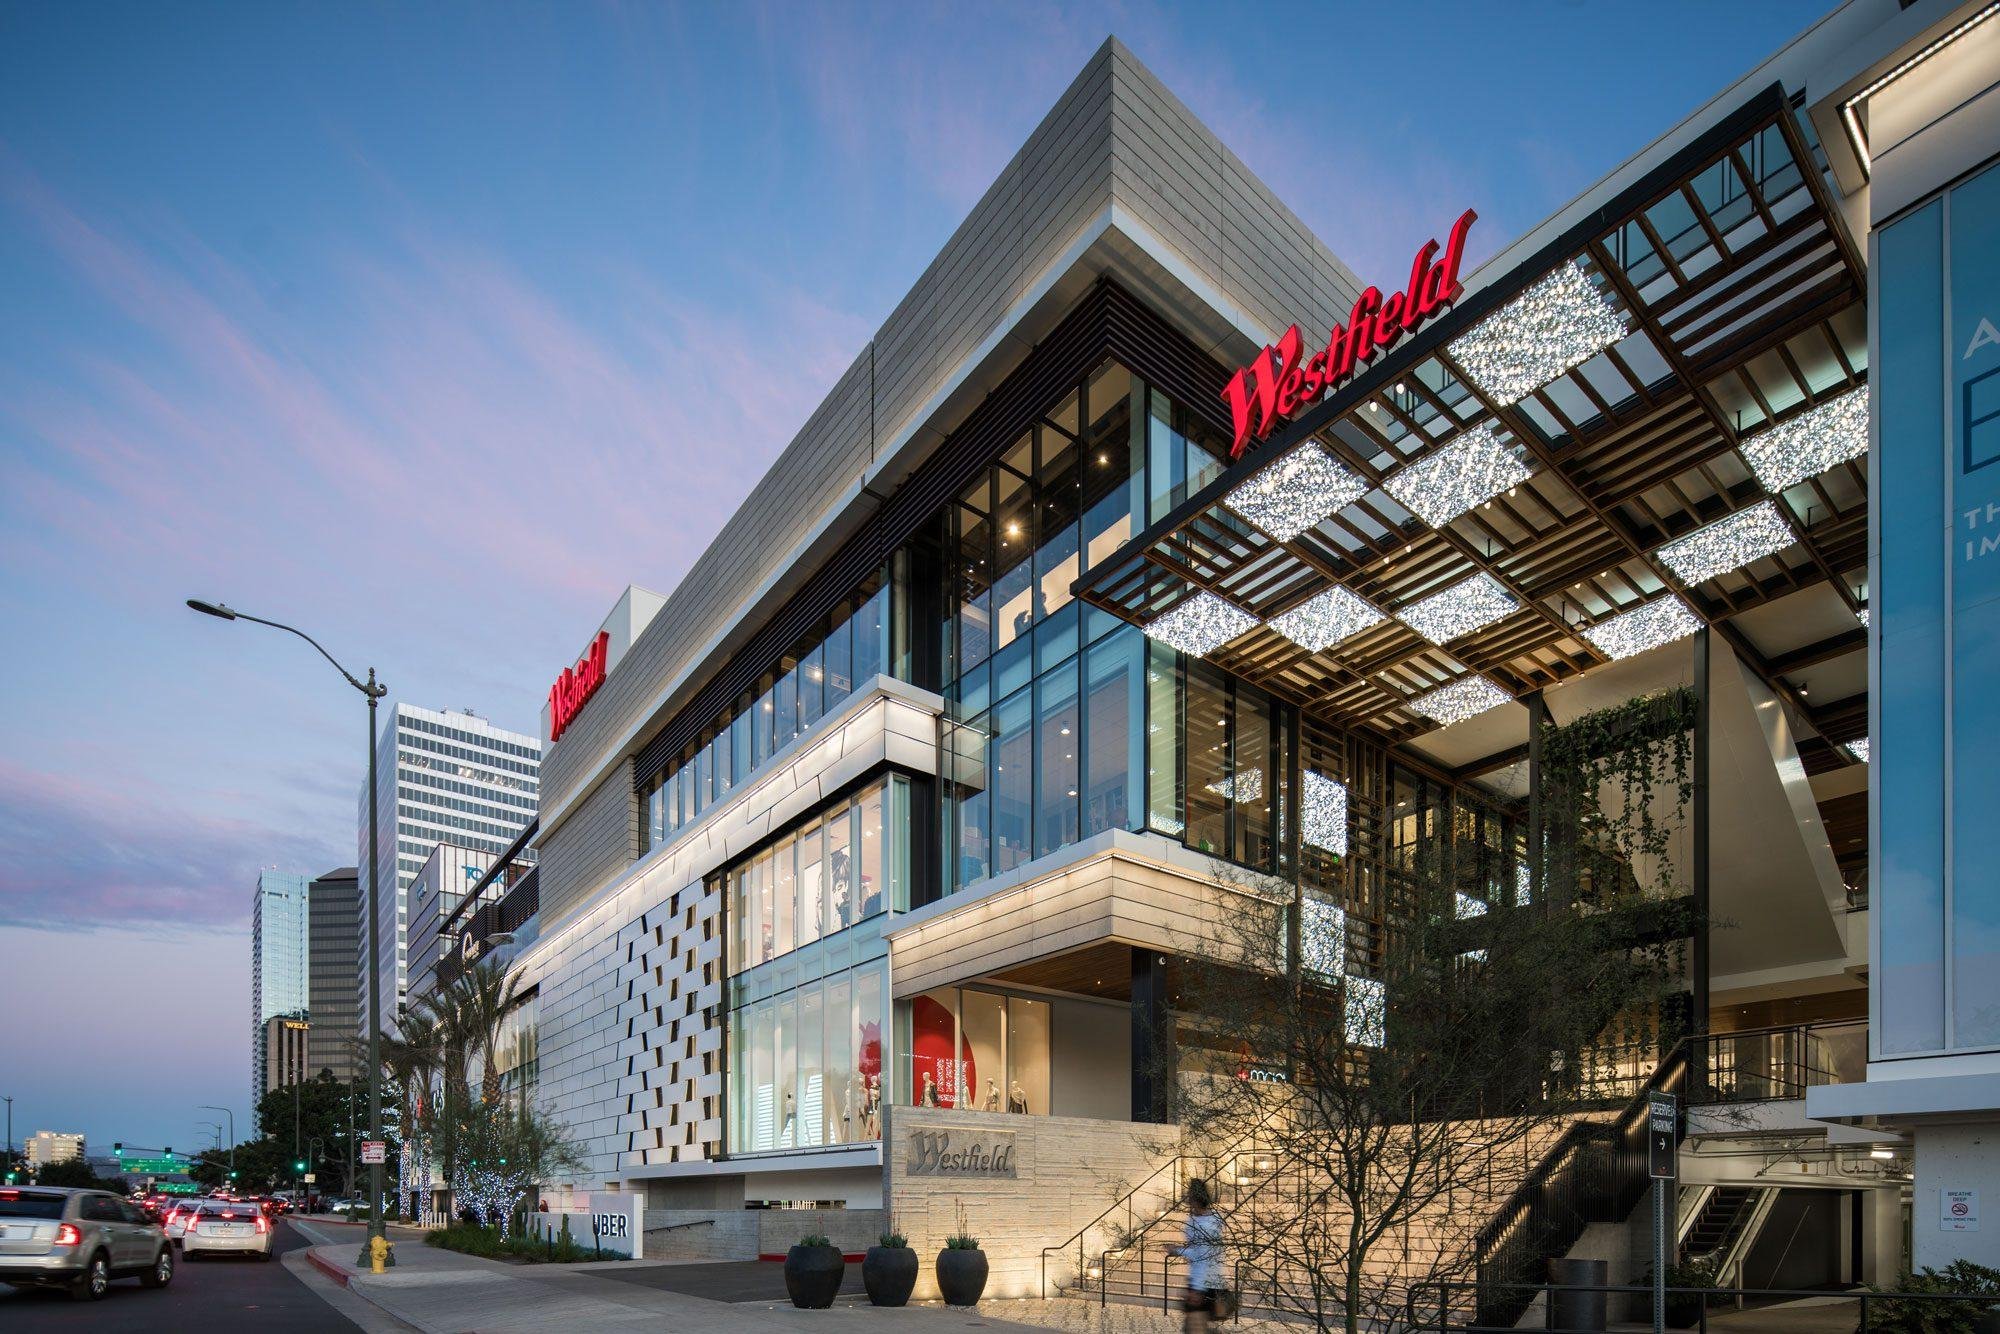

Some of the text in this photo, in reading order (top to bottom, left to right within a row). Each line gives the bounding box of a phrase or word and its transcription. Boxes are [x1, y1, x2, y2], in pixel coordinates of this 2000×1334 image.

[1221, 208, 1478, 463] Westfield
[1652, 1118, 1673, 1133] PARKING
[908, 1130, 1013, 1173] Westfield
[592, 1213, 628, 1238] UBER
